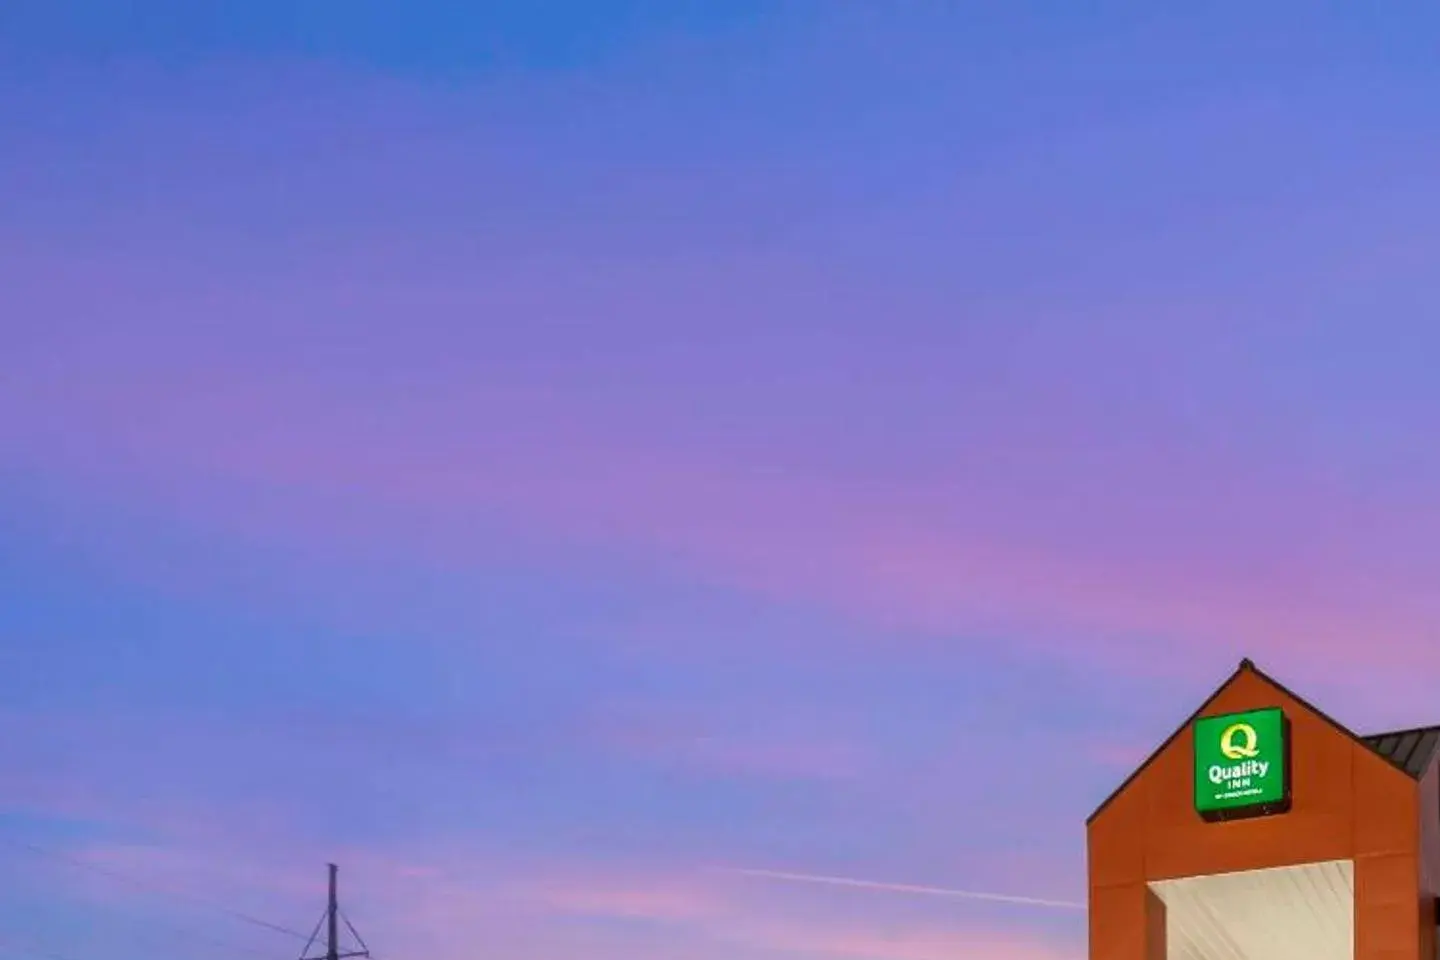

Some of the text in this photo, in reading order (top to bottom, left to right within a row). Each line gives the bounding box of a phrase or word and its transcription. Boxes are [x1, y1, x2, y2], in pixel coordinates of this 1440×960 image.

[1220, 723, 1259, 759] Q
[1208, 760, 1269, 784] Quality
[1227, 778, 1251, 789] INN
